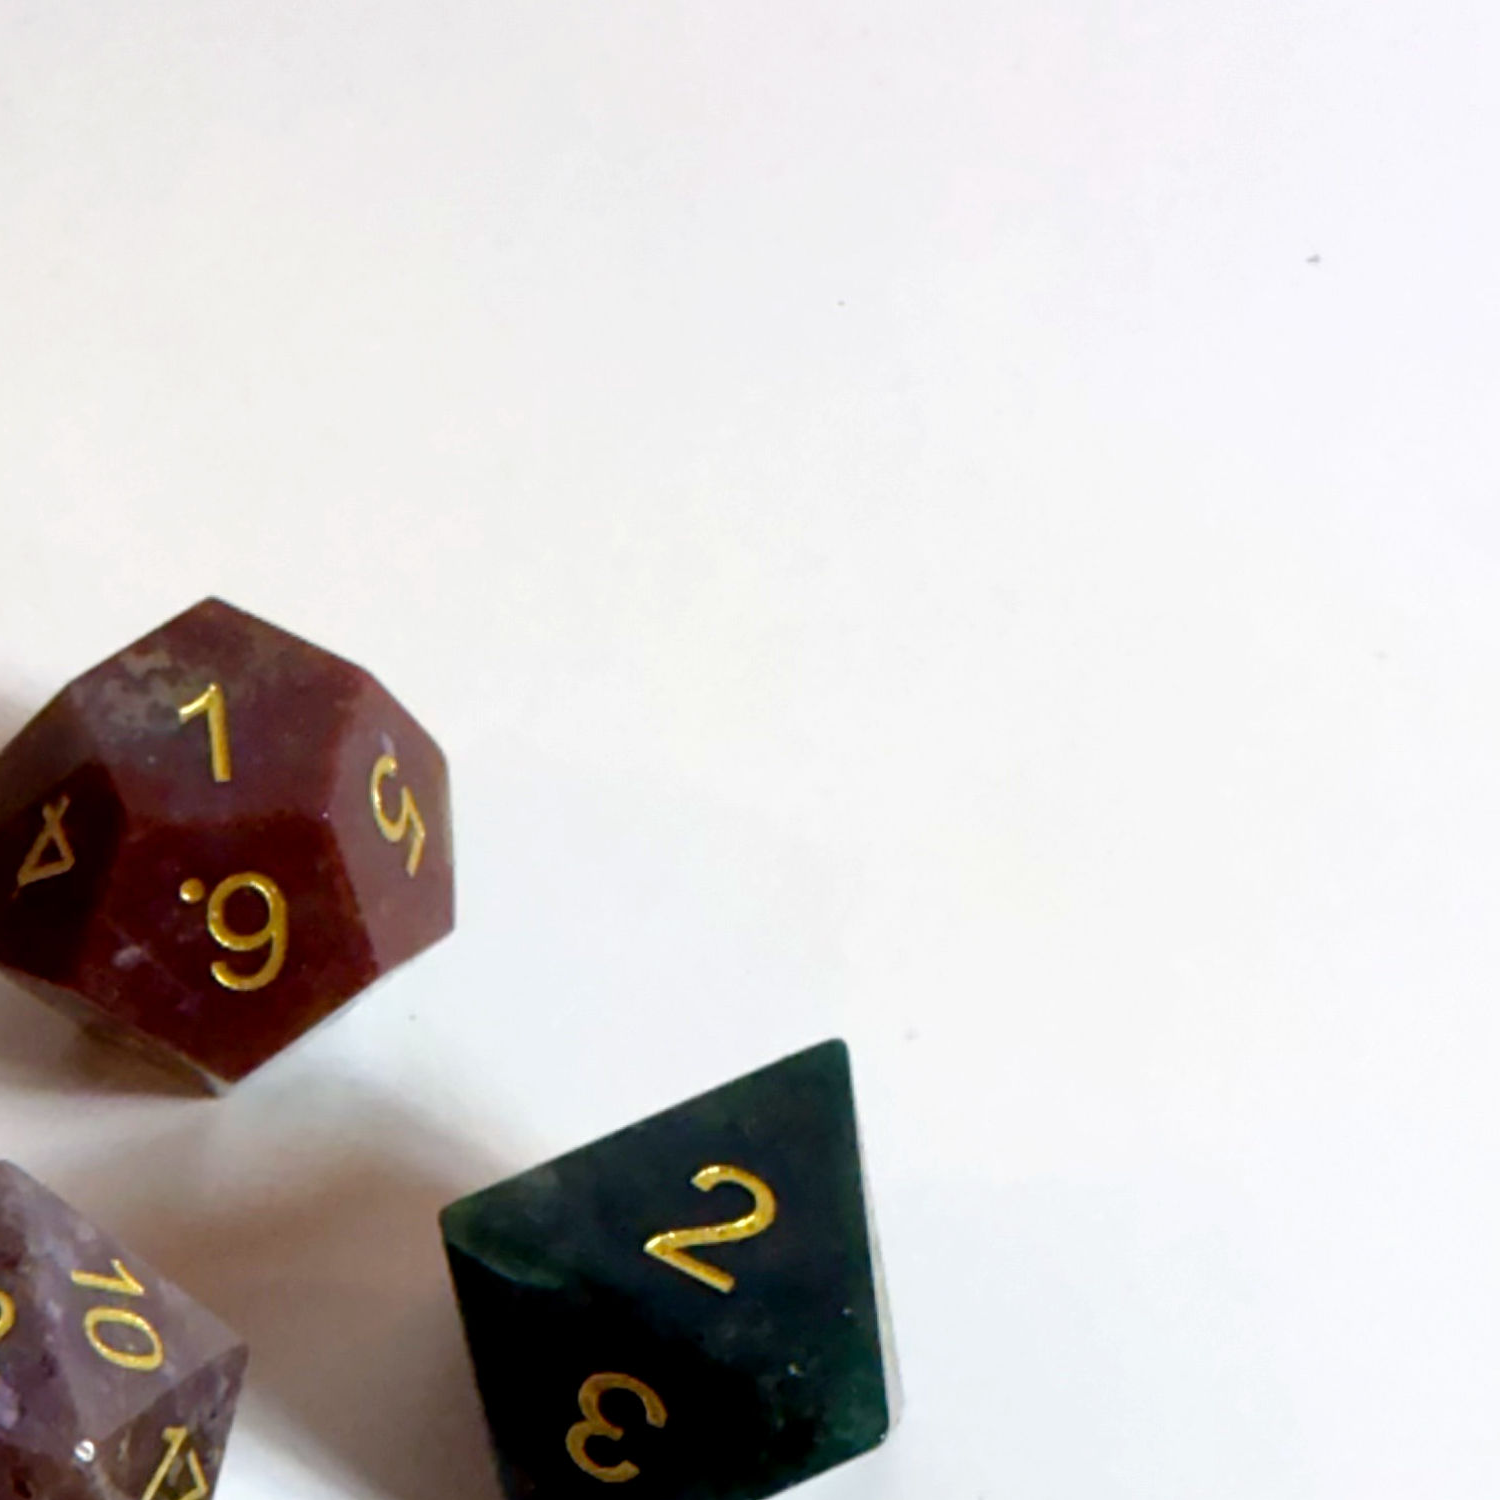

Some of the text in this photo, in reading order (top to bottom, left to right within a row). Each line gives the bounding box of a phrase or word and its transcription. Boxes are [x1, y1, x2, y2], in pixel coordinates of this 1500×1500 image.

[178, 682, 231, 782] 1
[11, 796, 75, 898] 4
[370, 755, 425, 877] 5
[643, 1164, 776, 1294] 2
[71, 1259, 163, 1371] 10
[565, 1371, 668, 1482] 3
